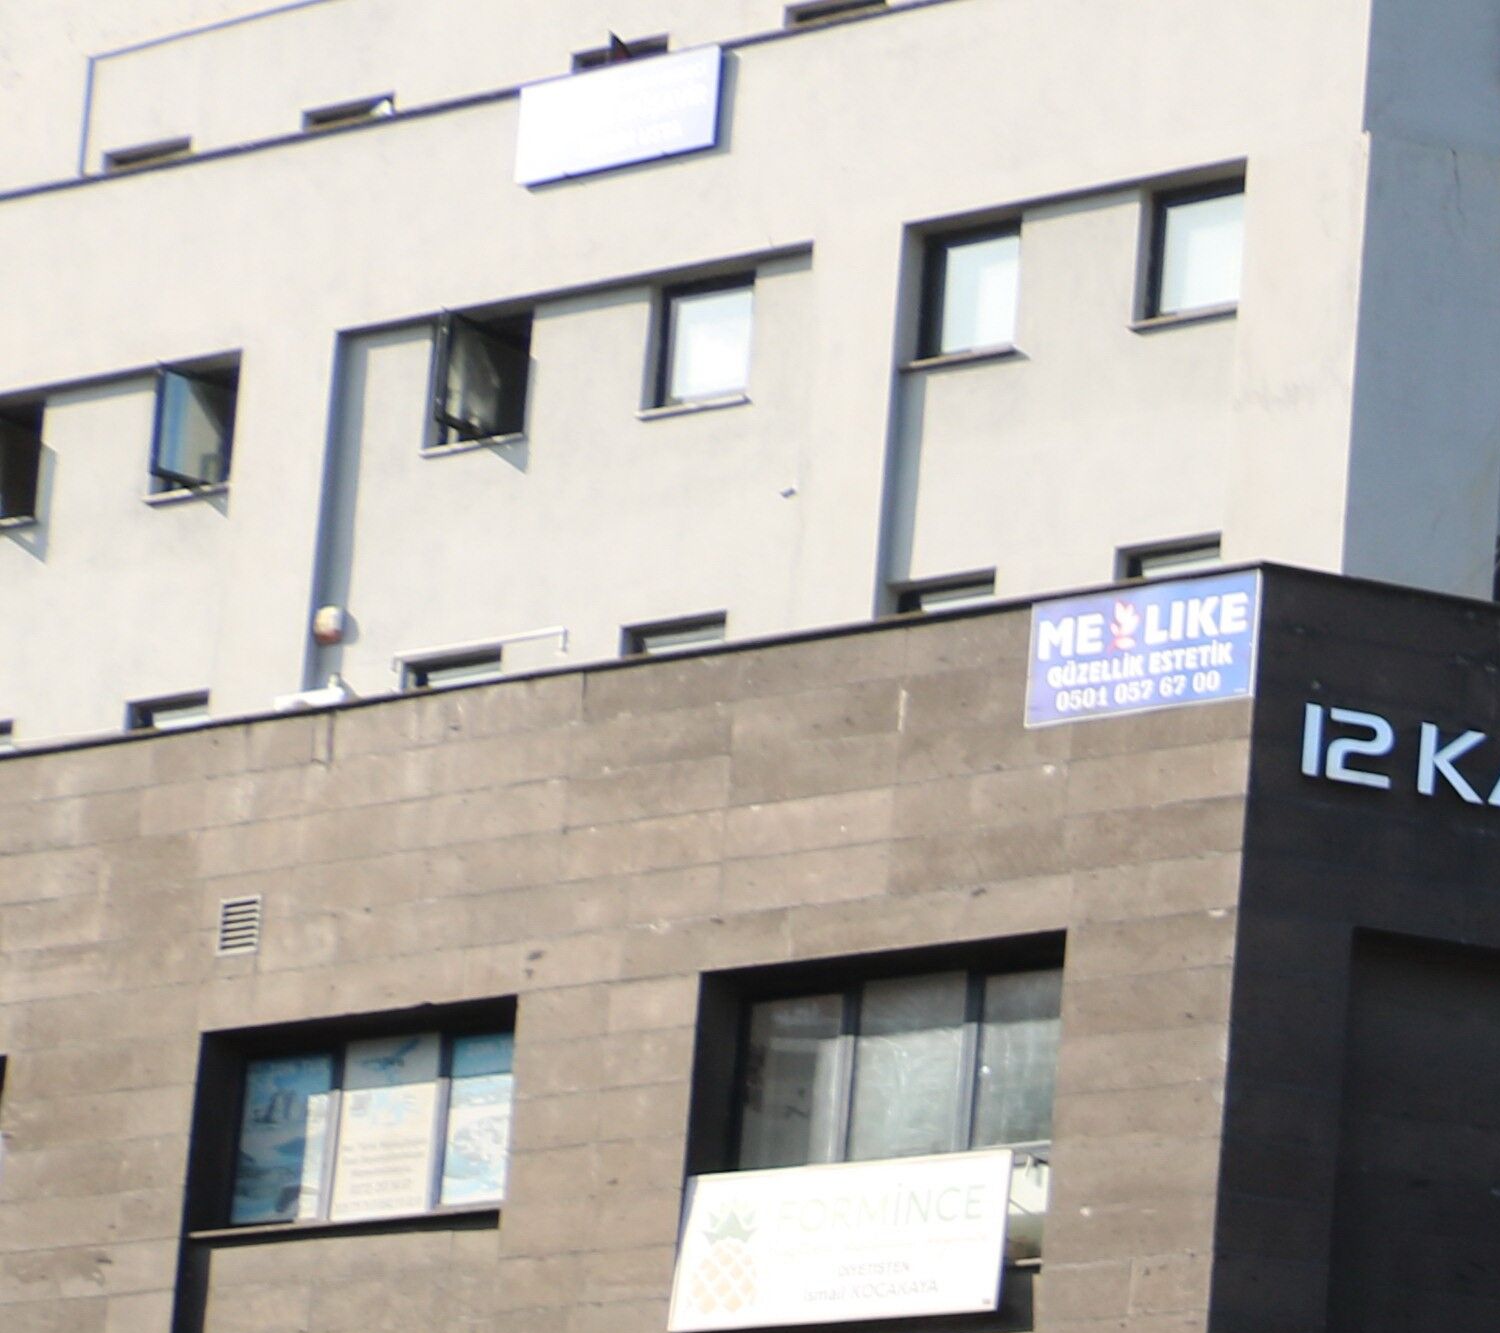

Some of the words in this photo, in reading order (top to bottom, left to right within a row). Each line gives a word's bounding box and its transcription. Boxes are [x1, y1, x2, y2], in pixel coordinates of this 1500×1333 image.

[1046, 652, 1145, 688] GÜZELLİK
[1148, 639, 1233, 675] ESTETİK
[1055, 686, 1108, 712] 0501
[1113, 679, 1154, 704] 057
[1159, 675, 1187, 698] 67
[1192, 670, 1221, 693] 00
[1301, 702, 1395, 789] 12
